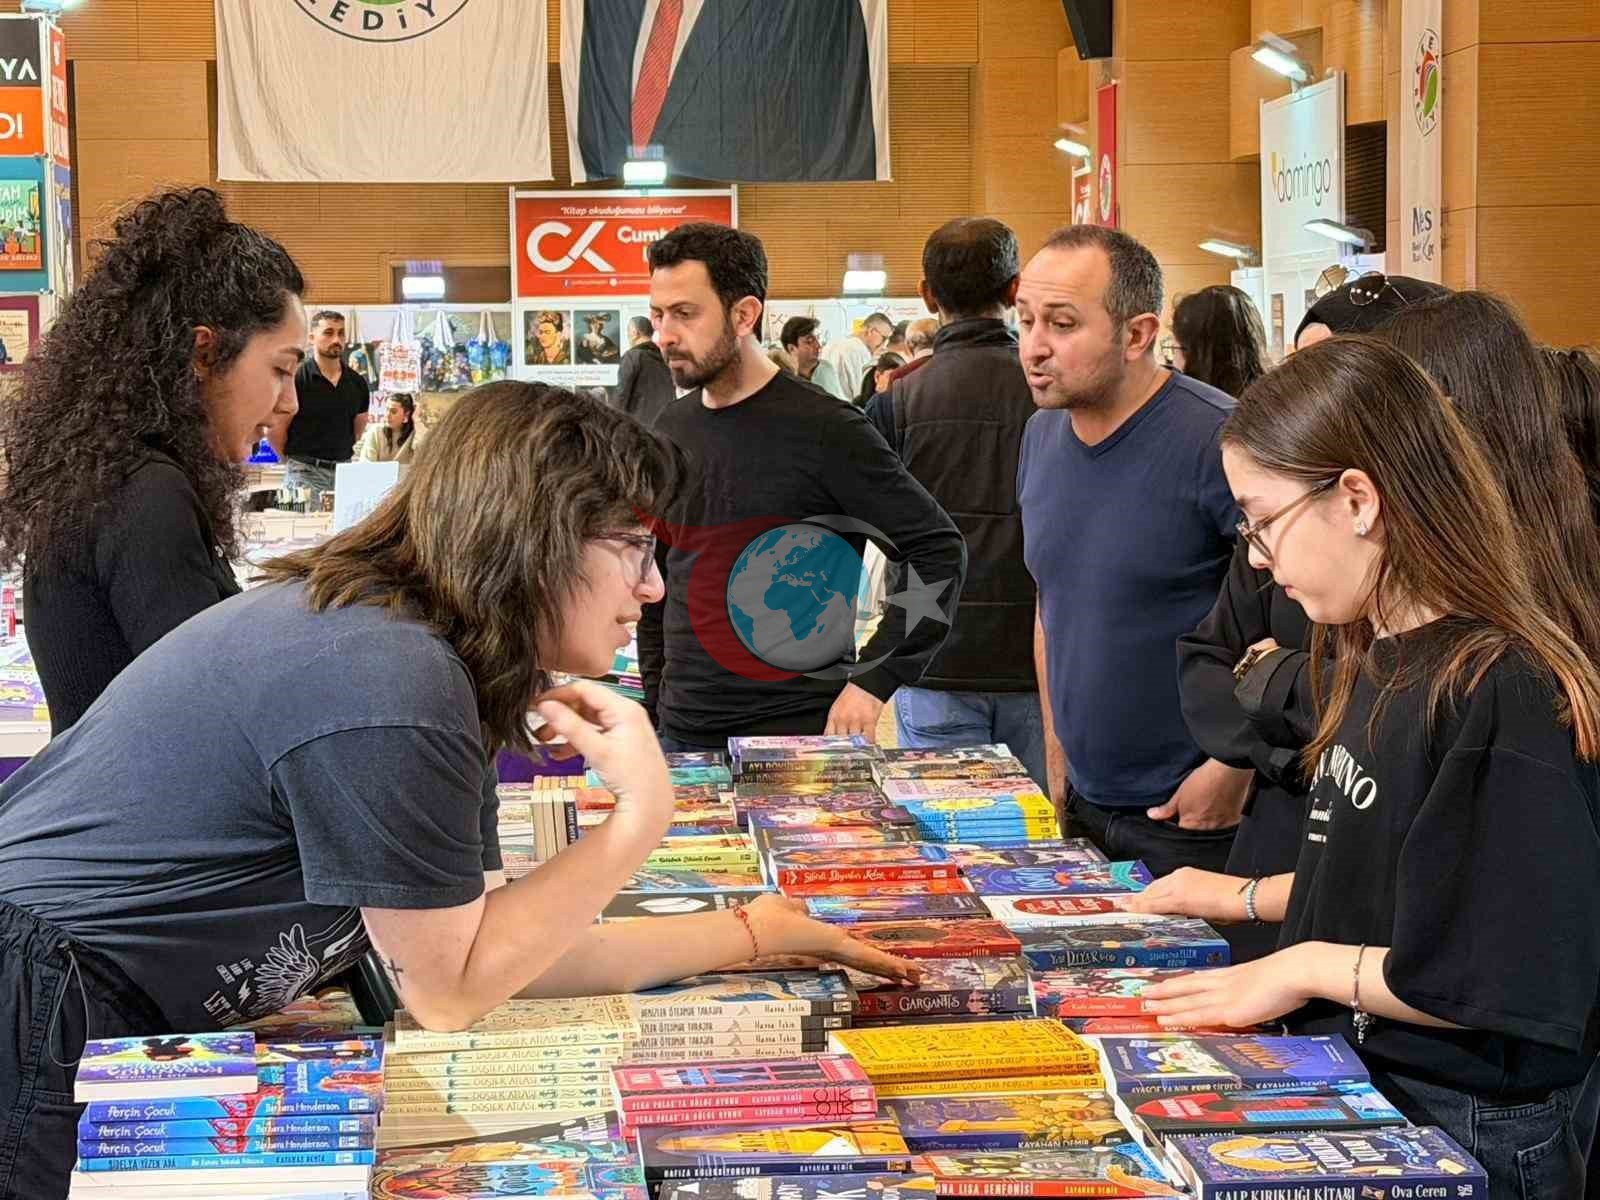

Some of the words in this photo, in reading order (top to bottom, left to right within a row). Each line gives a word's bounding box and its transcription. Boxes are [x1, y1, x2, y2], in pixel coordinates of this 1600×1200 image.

[1278, 152, 1331, 207] domingo
[107, 1105, 140, 1119] Perçin
[144, 1102, 176, 1120] Çocuk
[296, 1098, 340, 1113] Henderson
[98, 1124, 131, 1138] Perçin
[134, 1123, 168, 1139] Çocuk
[286, 1119, 331, 1133] Henderson
[97, 1142, 131, 1155] Perçin
[134, 1140, 168, 1156] Çocuk
[285, 1136, 330, 1150] Henderson
[1391, 1184, 1413, 1199] Ova
[1415, 1184, 1447, 1198] Ceren
